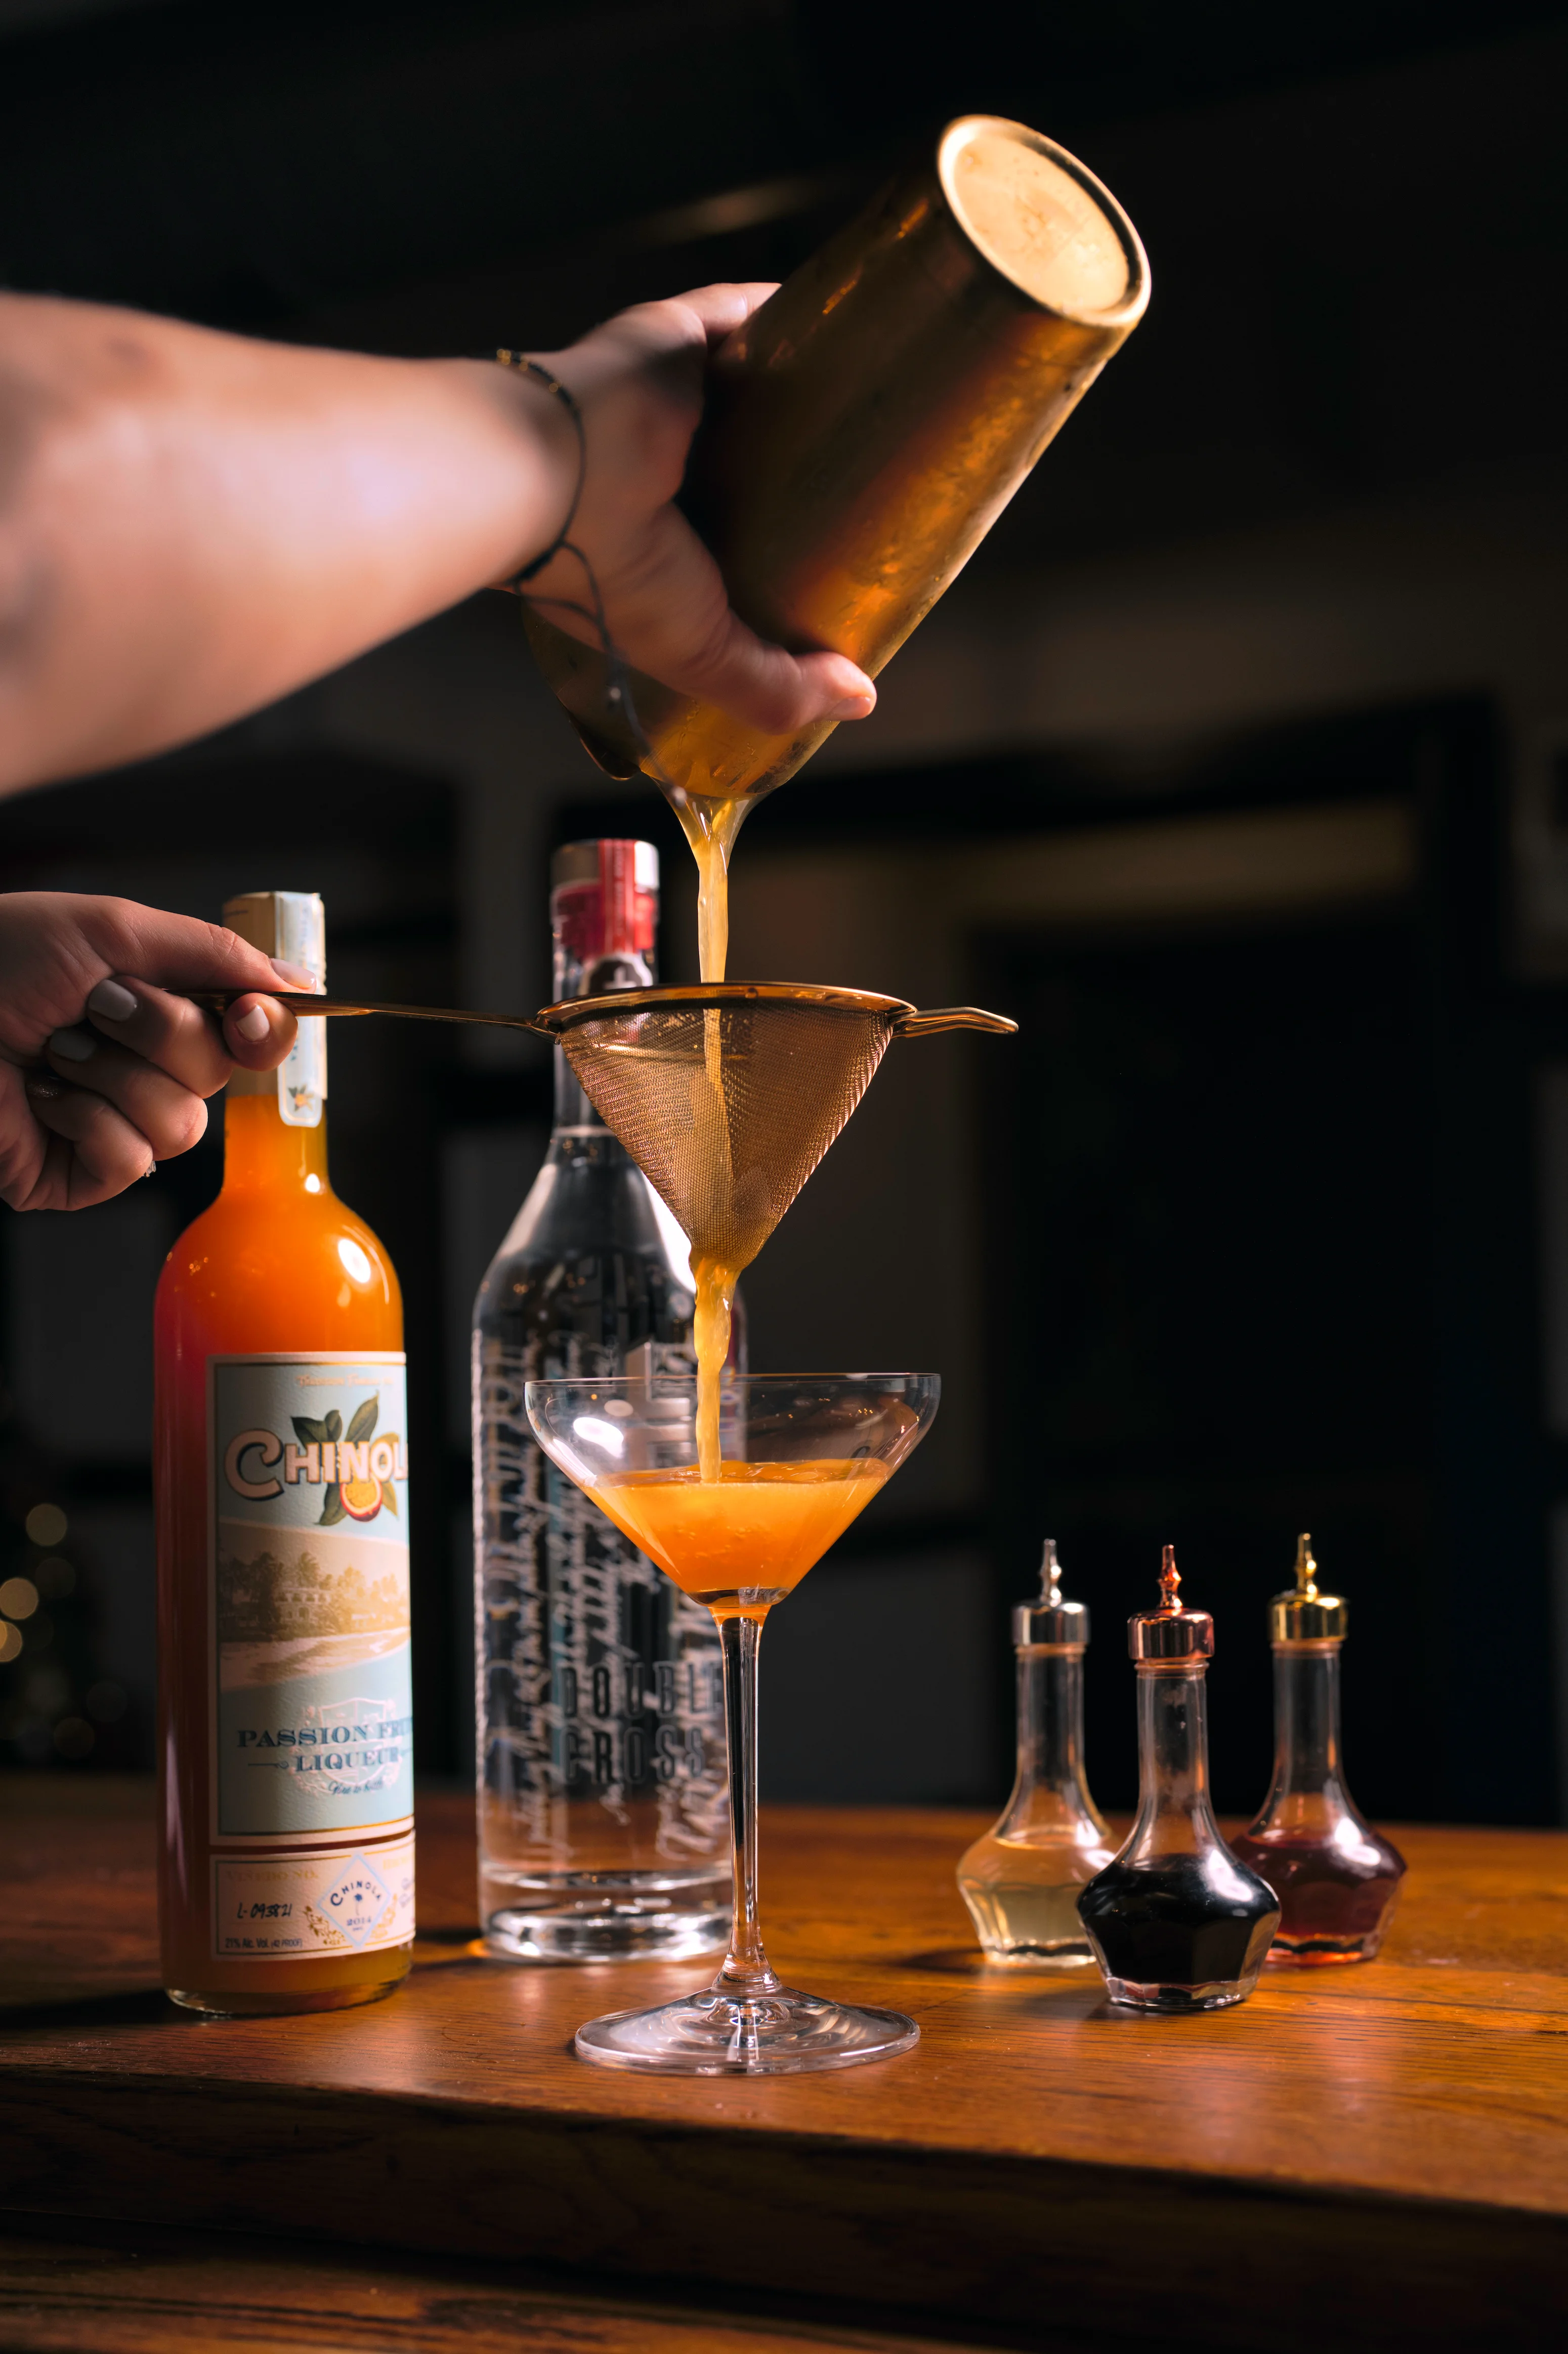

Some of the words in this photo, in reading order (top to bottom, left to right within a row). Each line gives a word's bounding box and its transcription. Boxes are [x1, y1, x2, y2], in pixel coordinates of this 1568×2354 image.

[225, 1428, 408, 1501] CHINOL
[559, 1660, 723, 1719] DOUBLE
[236, 1725, 369, 1748] PASSION
[559, 1724, 705, 1785] CROSS
[295, 1747, 399, 1772] LIQUEUR
[330, 1880, 381, 1907] CHINOLA
